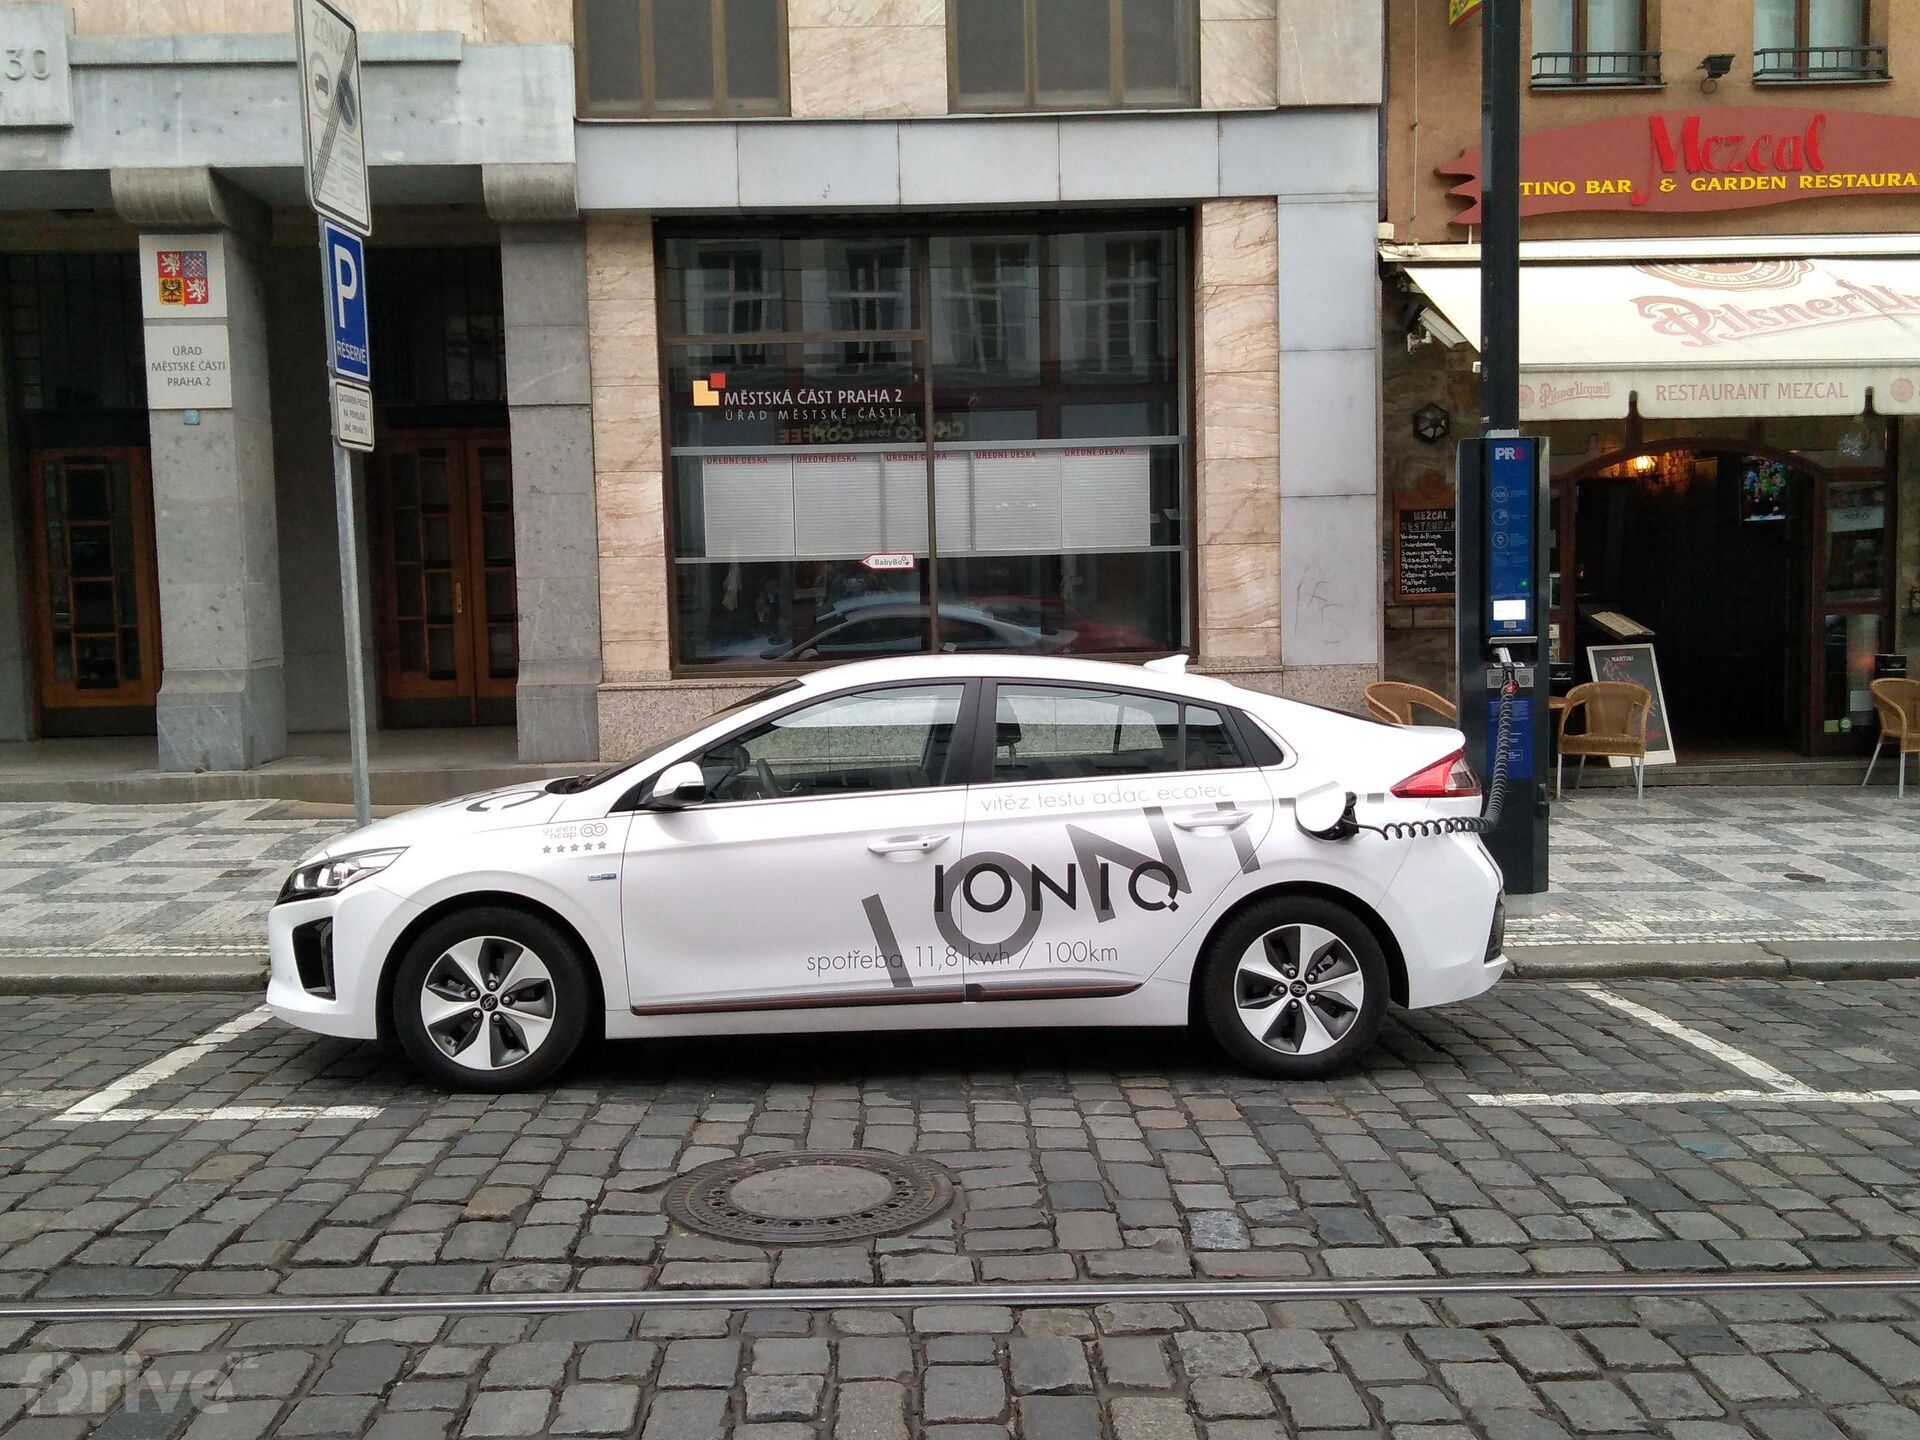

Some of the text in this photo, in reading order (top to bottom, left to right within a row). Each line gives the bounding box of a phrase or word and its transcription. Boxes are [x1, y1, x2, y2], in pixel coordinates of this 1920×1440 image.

[4, 48, 50, 80] 30
[1631, 112, 1828, 206] Mezcal
[1585, 179, 1632, 194] BAR
[1659, 178, 1677, 192] &
[1691, 175, 1786, 192] GARDEN
[334, 244, 357, 329] P
[172, 343, 202, 356] ÚŘAD
[151, 358, 226, 372] MĚSTSKÉ ČÁSTI
[167, 376, 212, 387] PRAHA 2
[724, 388, 902, 406] MĚSTSKÁ ČÁST PRAHA 2
[1656, 381, 1849, 401] RESTAURANT MEZCAL
[725, 407, 767, 421] ÚŘAD
[778, 407, 847, 420] MĚSTSKÉ
[857, 406, 902, 419] ČÁSTI
[742, 455, 768, 465] DESKA
[831, 453, 858, 463] DESKA
[1010, 449, 1037, 460] DESKA
[1099, 446, 1125, 457] DESKA
[1038, 792, 1085, 809] testu
[1093, 784, 1150, 804] adac
[1157, 783, 1231, 801] ecotec
[934, 861, 1180, 913] IONIQ
[806, 939, 1119, 977] spotřeba 11,8 kwh / 100km
